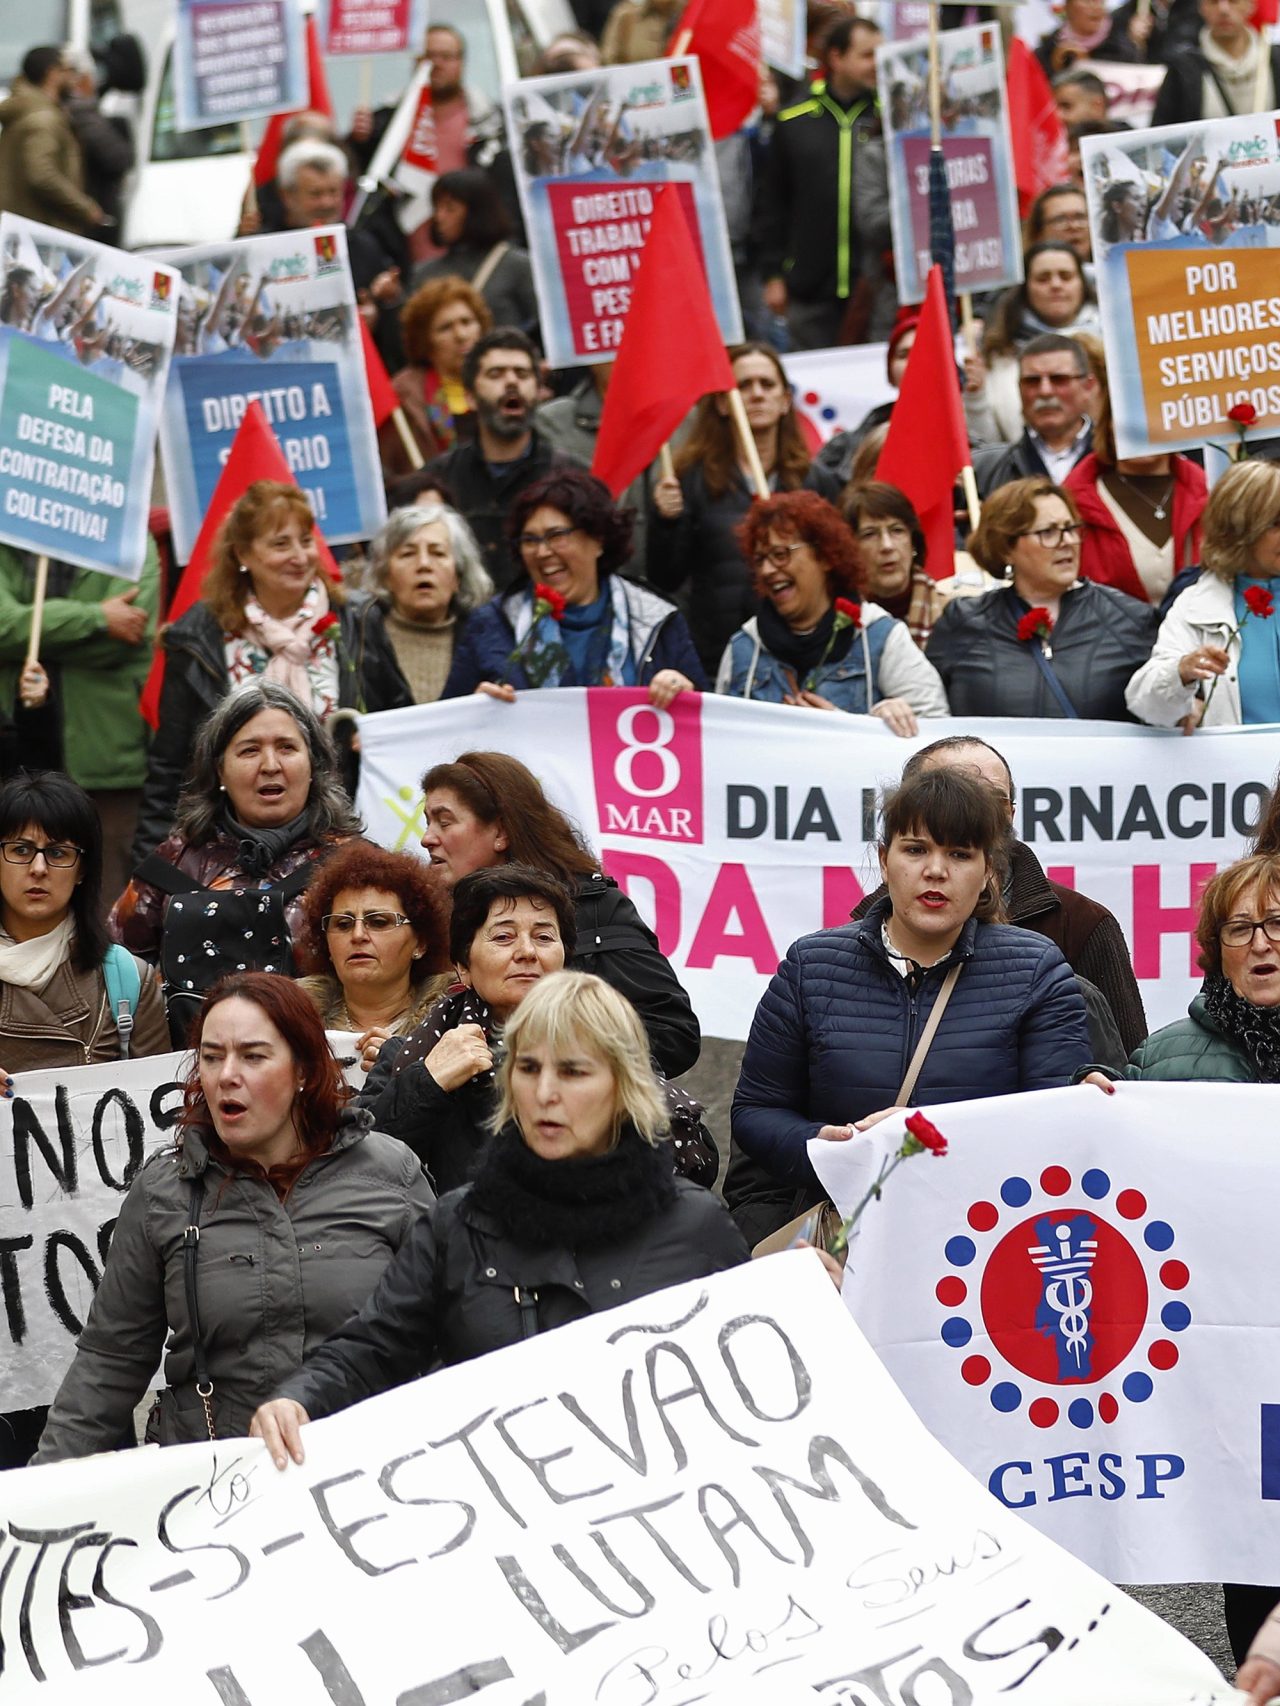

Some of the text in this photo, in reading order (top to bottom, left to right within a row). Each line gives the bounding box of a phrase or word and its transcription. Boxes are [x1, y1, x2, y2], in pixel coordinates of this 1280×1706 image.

[582, 255, 631, 287] COM
[1186, 262, 1238, 296] POR
[592, 286, 632, 317] PES
[582, 322, 599, 350] E
[49, 383, 94, 421] PELA
[312, 383, 333, 418] A
[17, 413, 115, 467] DEFESA DA
[0, 446, 125, 509] CONTRATAÇÃO
[5, 488, 108, 543] COLECTIVA!
[614, 704, 681, 798] 8
[606, 803, 695, 838] MAR
[726, 784, 842, 842] DIA
[309, 1290, 811, 1577] ESTEVÃO
[988, 1452, 1185, 1509] CESP
[495, 1436, 918, 1656] LUTAM
